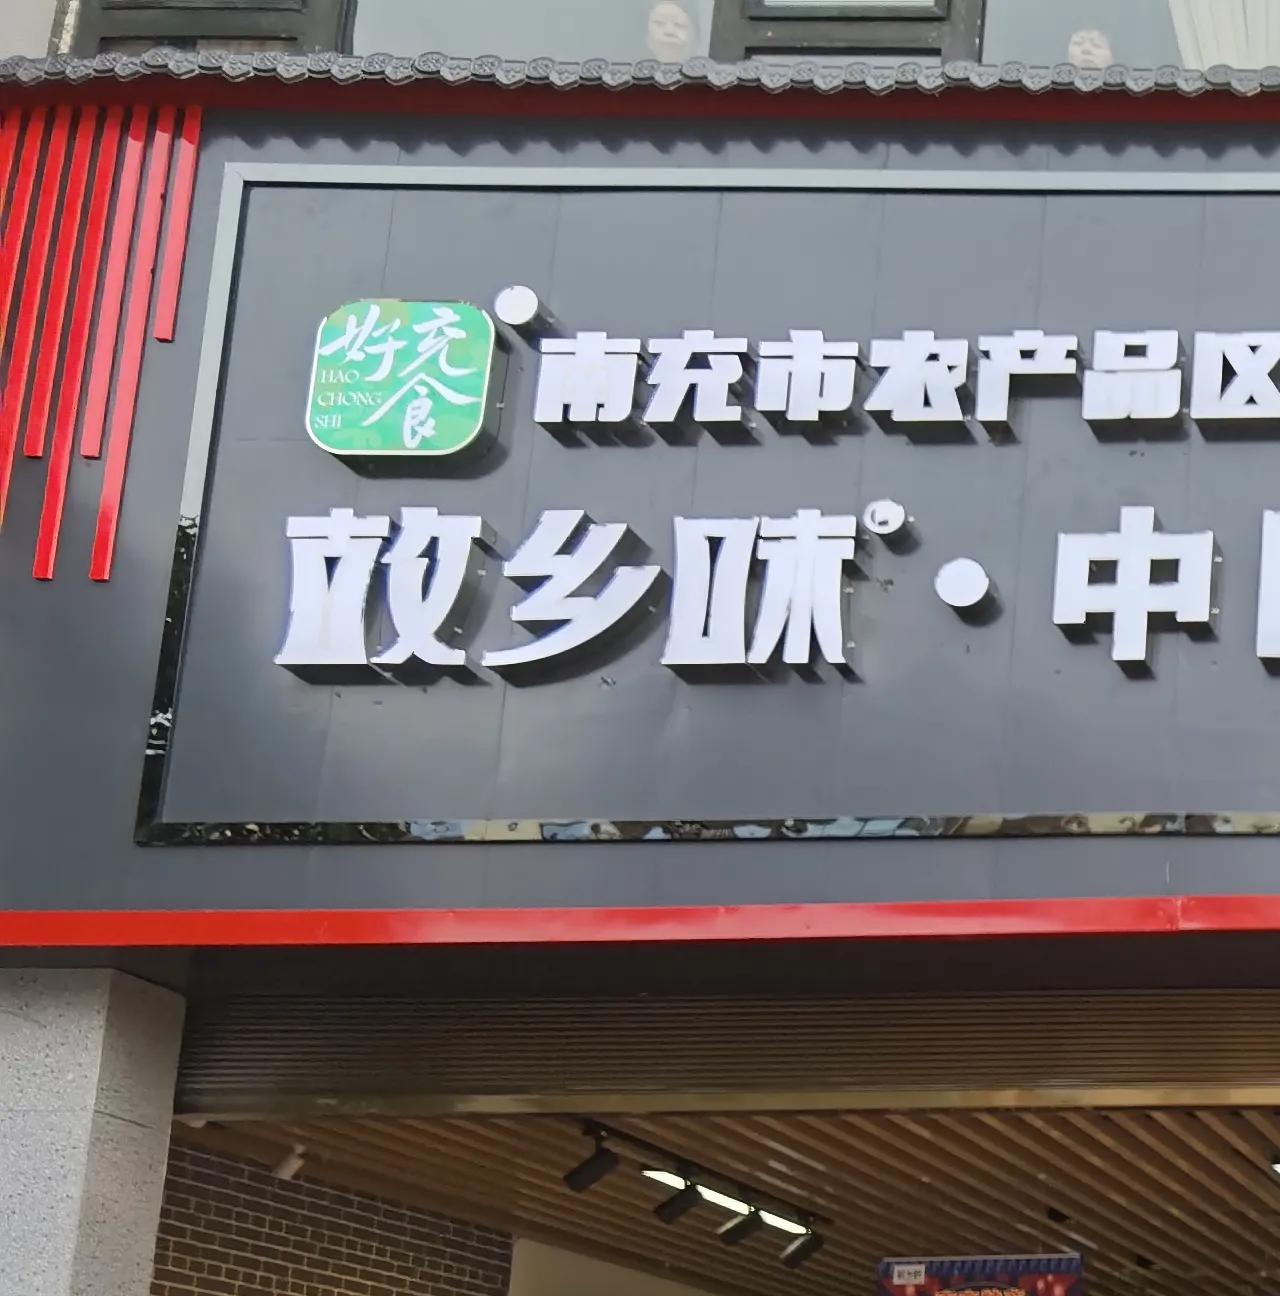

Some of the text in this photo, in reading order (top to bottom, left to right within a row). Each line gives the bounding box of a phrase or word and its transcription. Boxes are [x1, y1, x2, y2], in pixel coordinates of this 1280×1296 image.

[320, 369, 360, 385] HAO
[317, 391, 382, 407] CHONG
[314, 413, 342, 429] SHI
